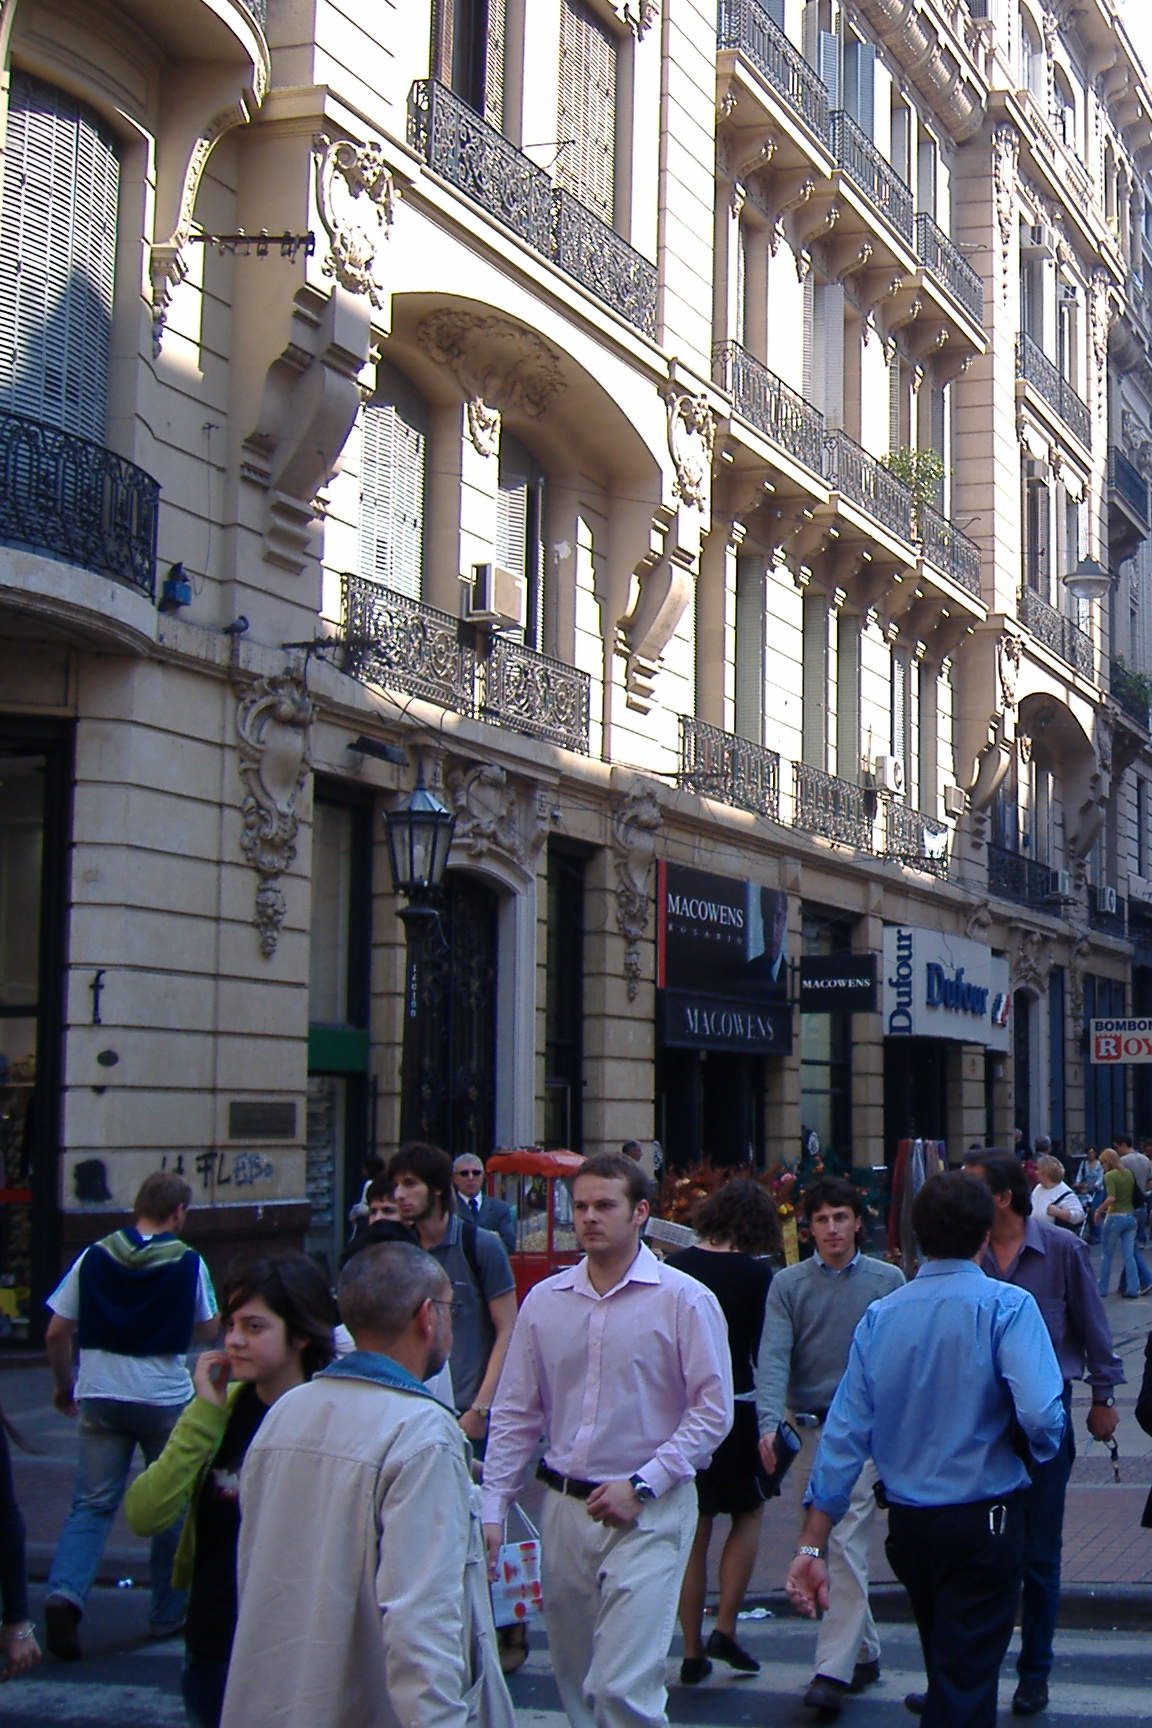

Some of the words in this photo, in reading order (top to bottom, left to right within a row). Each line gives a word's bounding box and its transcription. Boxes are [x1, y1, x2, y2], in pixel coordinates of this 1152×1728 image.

[667, 892, 744, 928] MACOWENS
[802, 979, 871, 989] MACOWENS
[888, 929, 912, 1034] Dufour
[926, 962, 989, 1016] Dufour
[686, 1007, 774, 1040] MACOWENS
